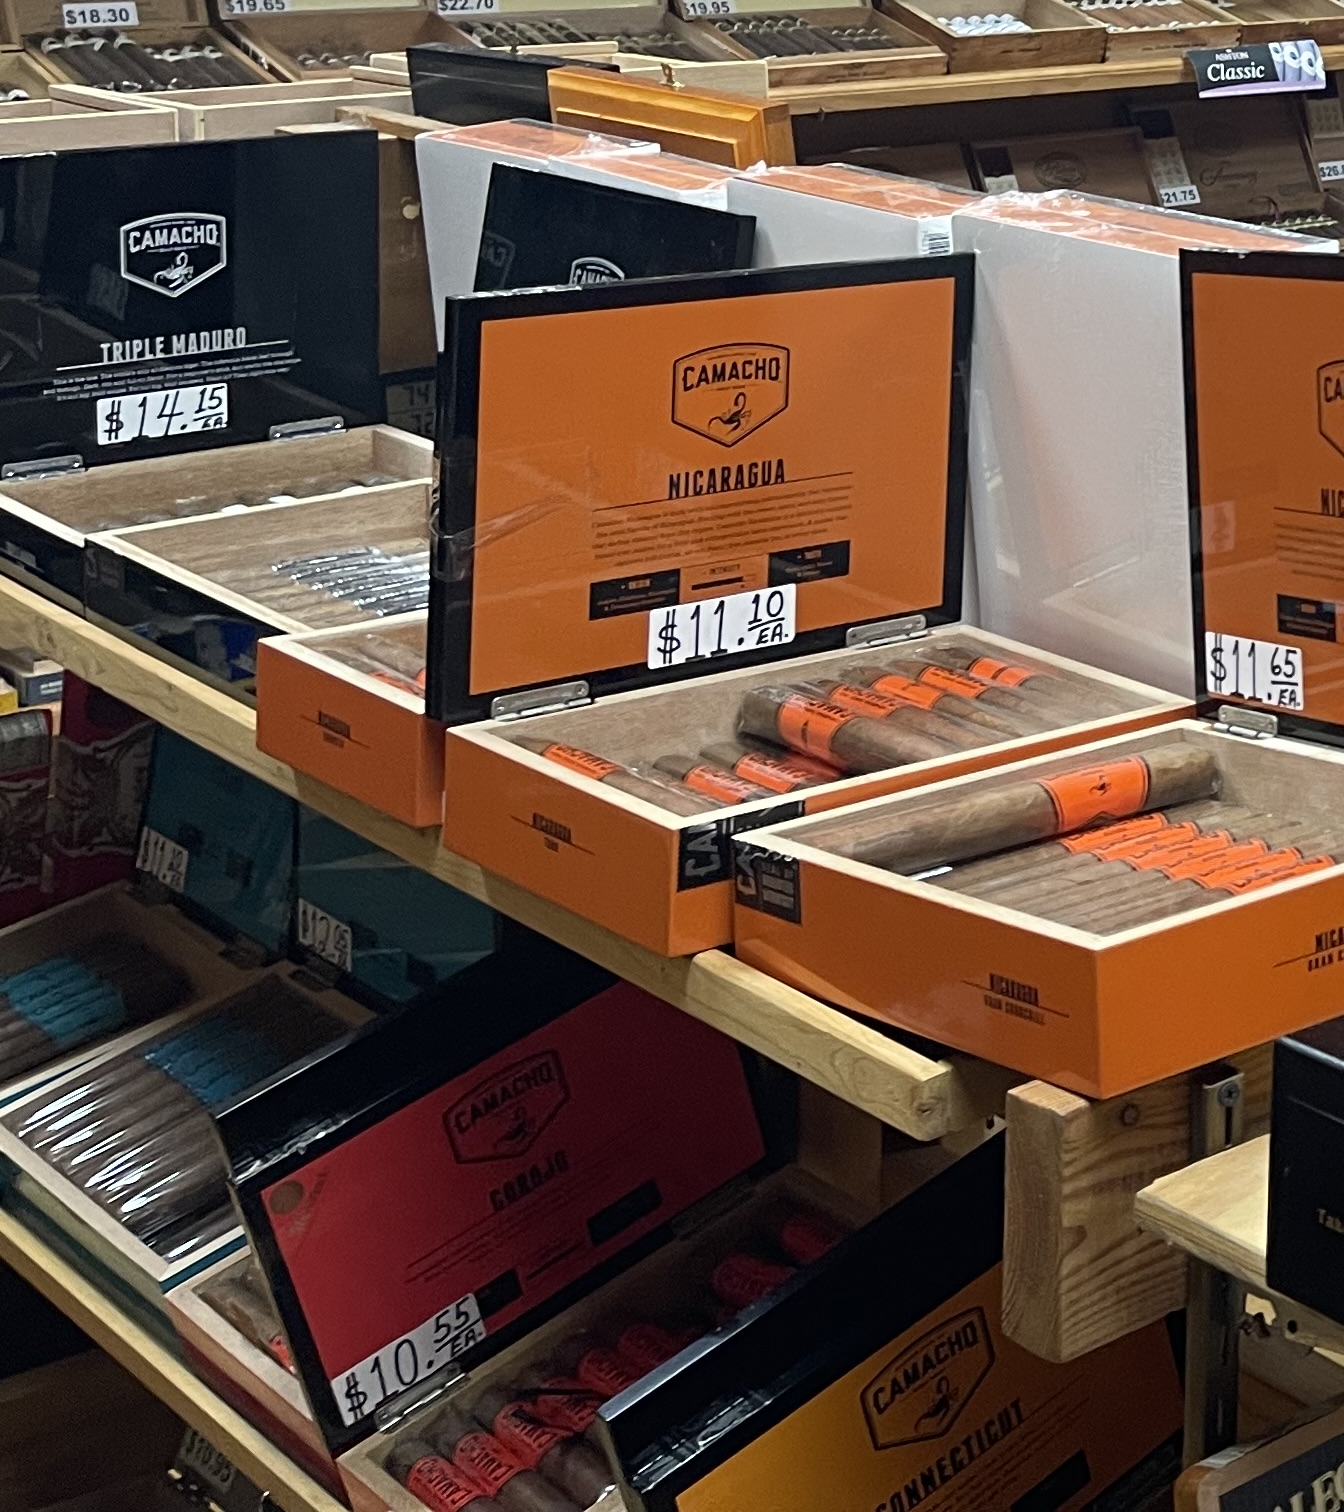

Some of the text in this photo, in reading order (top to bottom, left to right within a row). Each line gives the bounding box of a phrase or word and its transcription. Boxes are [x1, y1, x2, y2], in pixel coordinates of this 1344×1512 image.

[66, 9, 130, 25] $18.30
[1207, 61, 1265, 83] Classic
[129, 225, 218, 254] CAMACHO
[101, 327, 247, 364] TRIPLE MADURO
[683, 356, 781, 392] CAMACHO
[669, 458, 786, 500] NICARAGUA
[455, 1064, 558, 1135] CAMACHO
[488, 1150, 569, 1214] COROJO
[343, 1296, 486, 1420] $10.55 EA.
[872, 1319, 980, 1416] CAMACHO
